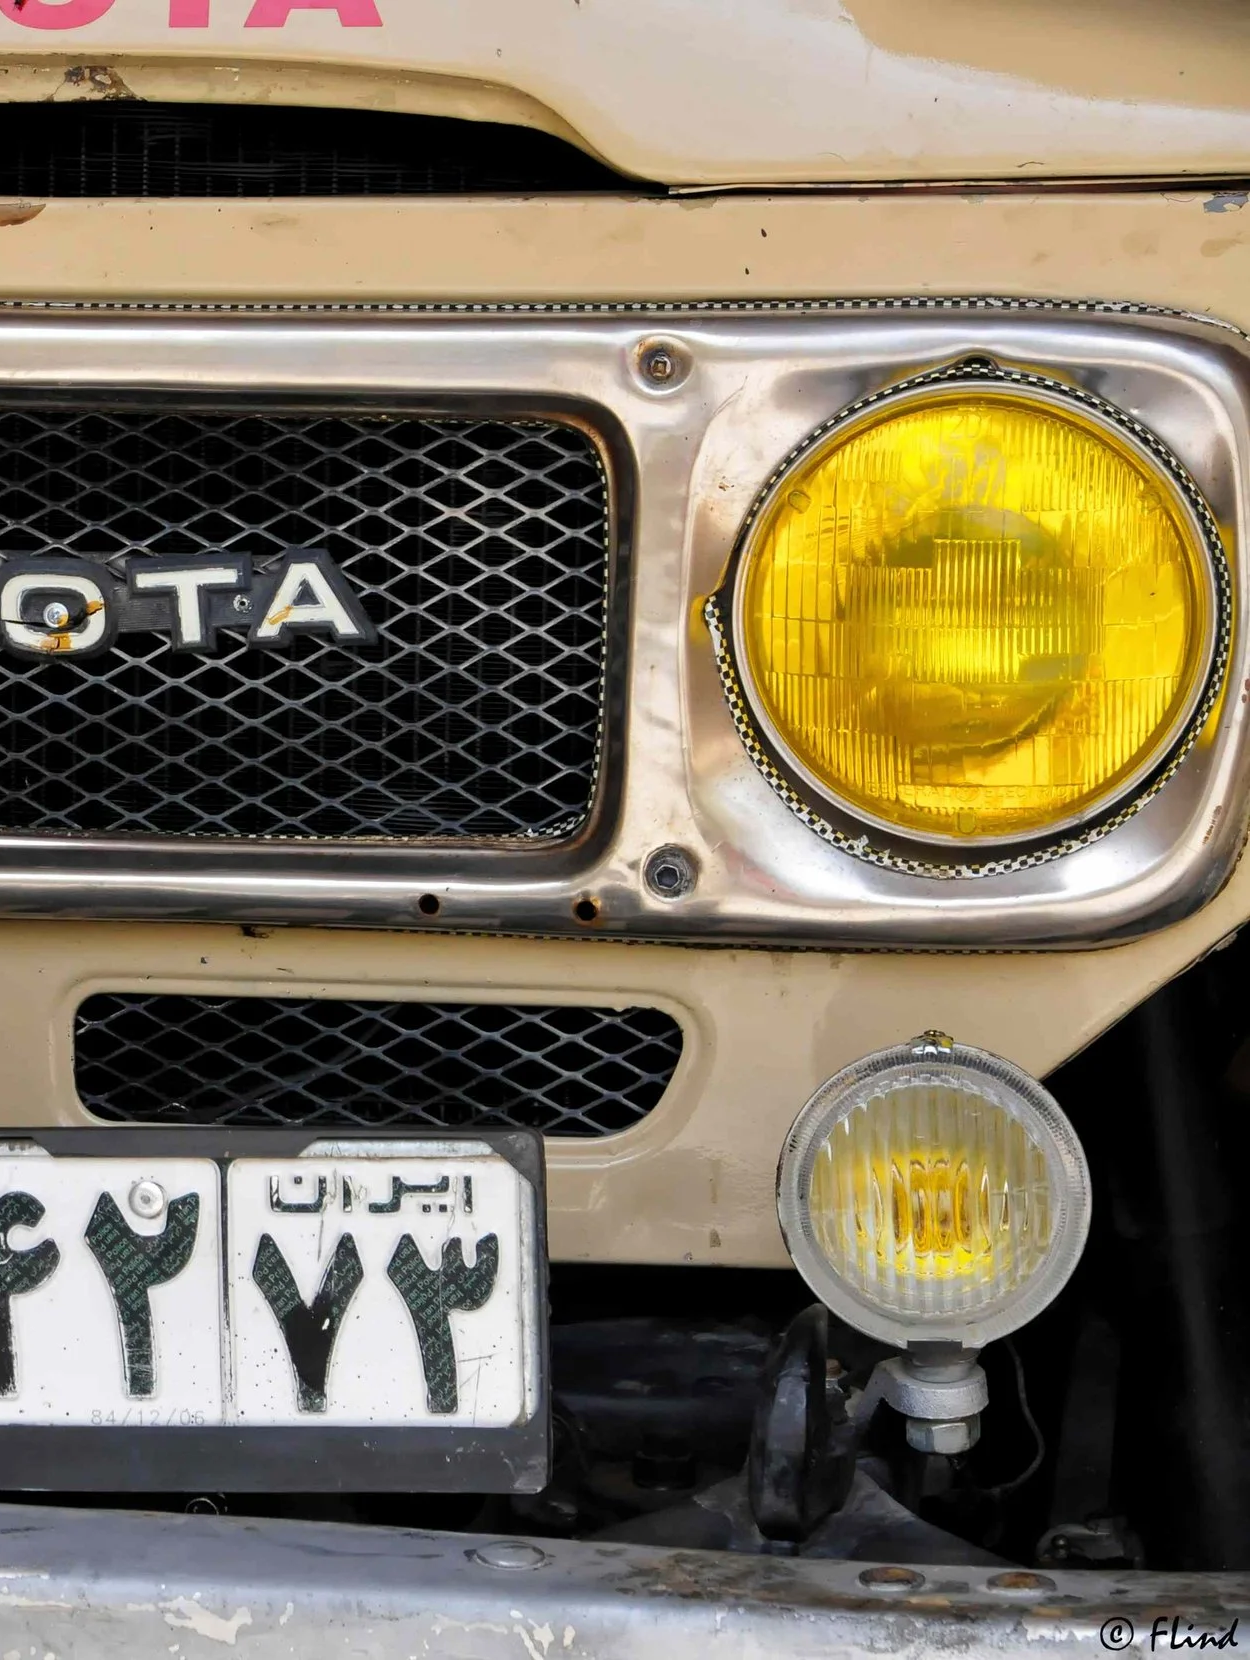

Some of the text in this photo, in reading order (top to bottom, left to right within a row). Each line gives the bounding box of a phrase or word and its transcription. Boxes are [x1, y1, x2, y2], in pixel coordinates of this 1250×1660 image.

[269, 1175, 473, 1215] ایران
[252, 1231, 500, 1414] ۷۳
[90, 1406, 206, 1427] 84/12/06
